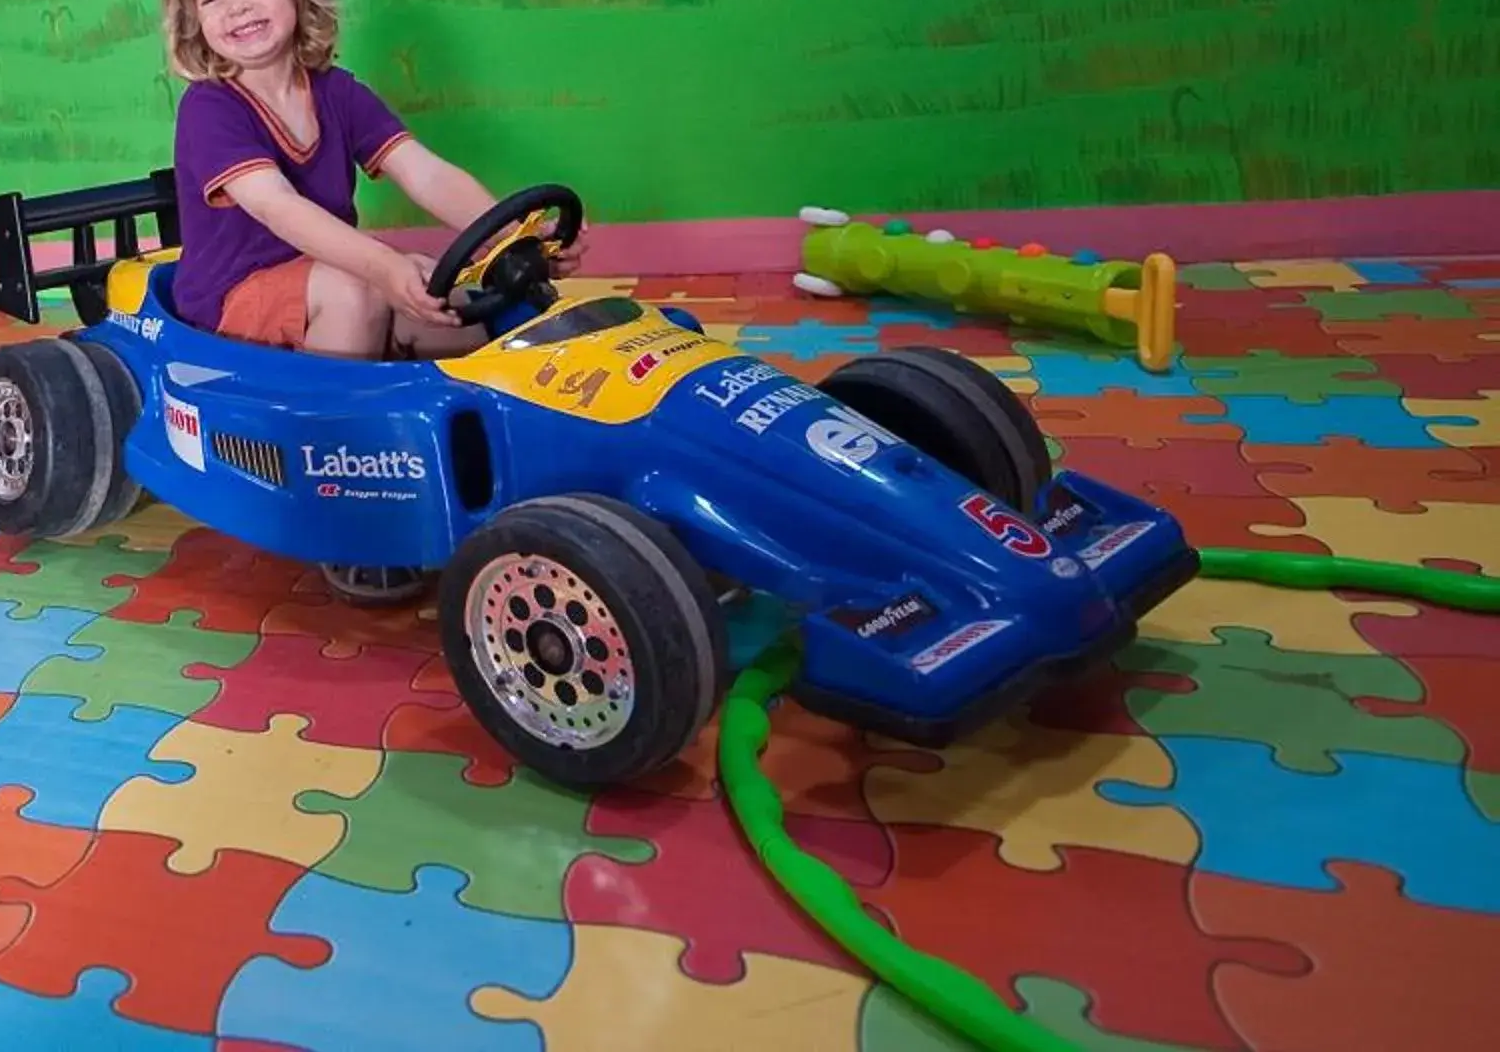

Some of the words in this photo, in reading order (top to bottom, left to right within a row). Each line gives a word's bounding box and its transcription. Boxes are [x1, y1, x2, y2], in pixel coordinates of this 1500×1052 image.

[300, 445, 426, 479] Labatt's
[958, 494, 1051, 557] 5
[856, 599, 921, 639] GOODYEAR
